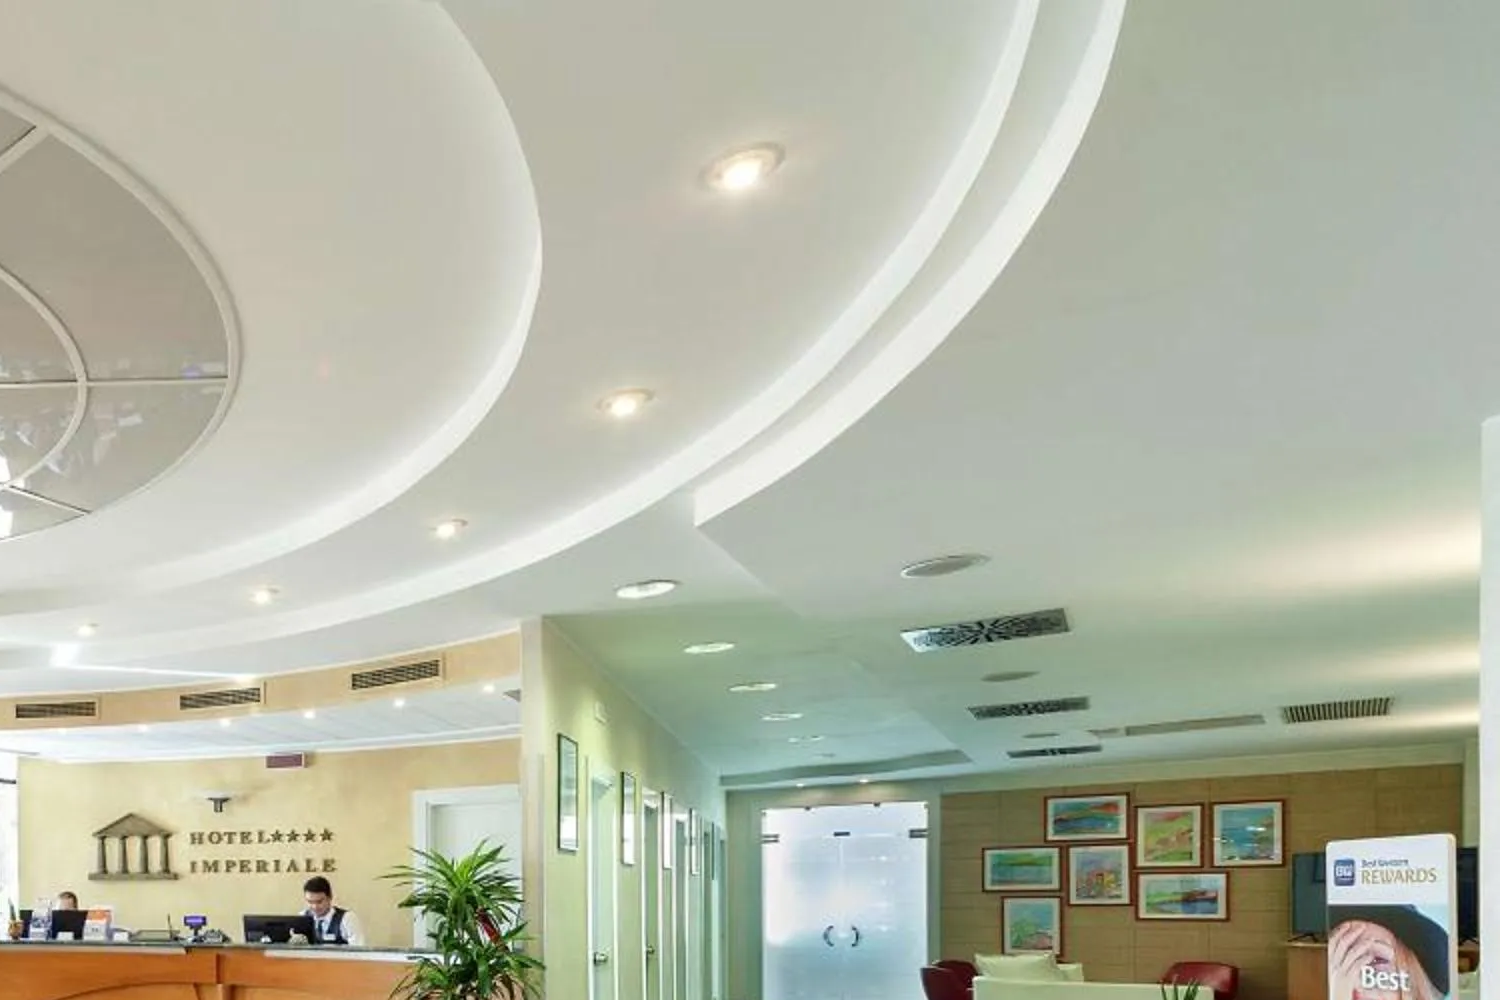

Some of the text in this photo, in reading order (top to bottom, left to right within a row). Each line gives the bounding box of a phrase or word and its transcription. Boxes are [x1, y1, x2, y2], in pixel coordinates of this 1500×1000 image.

[189, 830, 271, 845] HOTEL
[189, 857, 338, 873] IMPERIALE
[1361, 867, 1437, 885] REWARDS
[1361, 965, 1411, 992] Best
